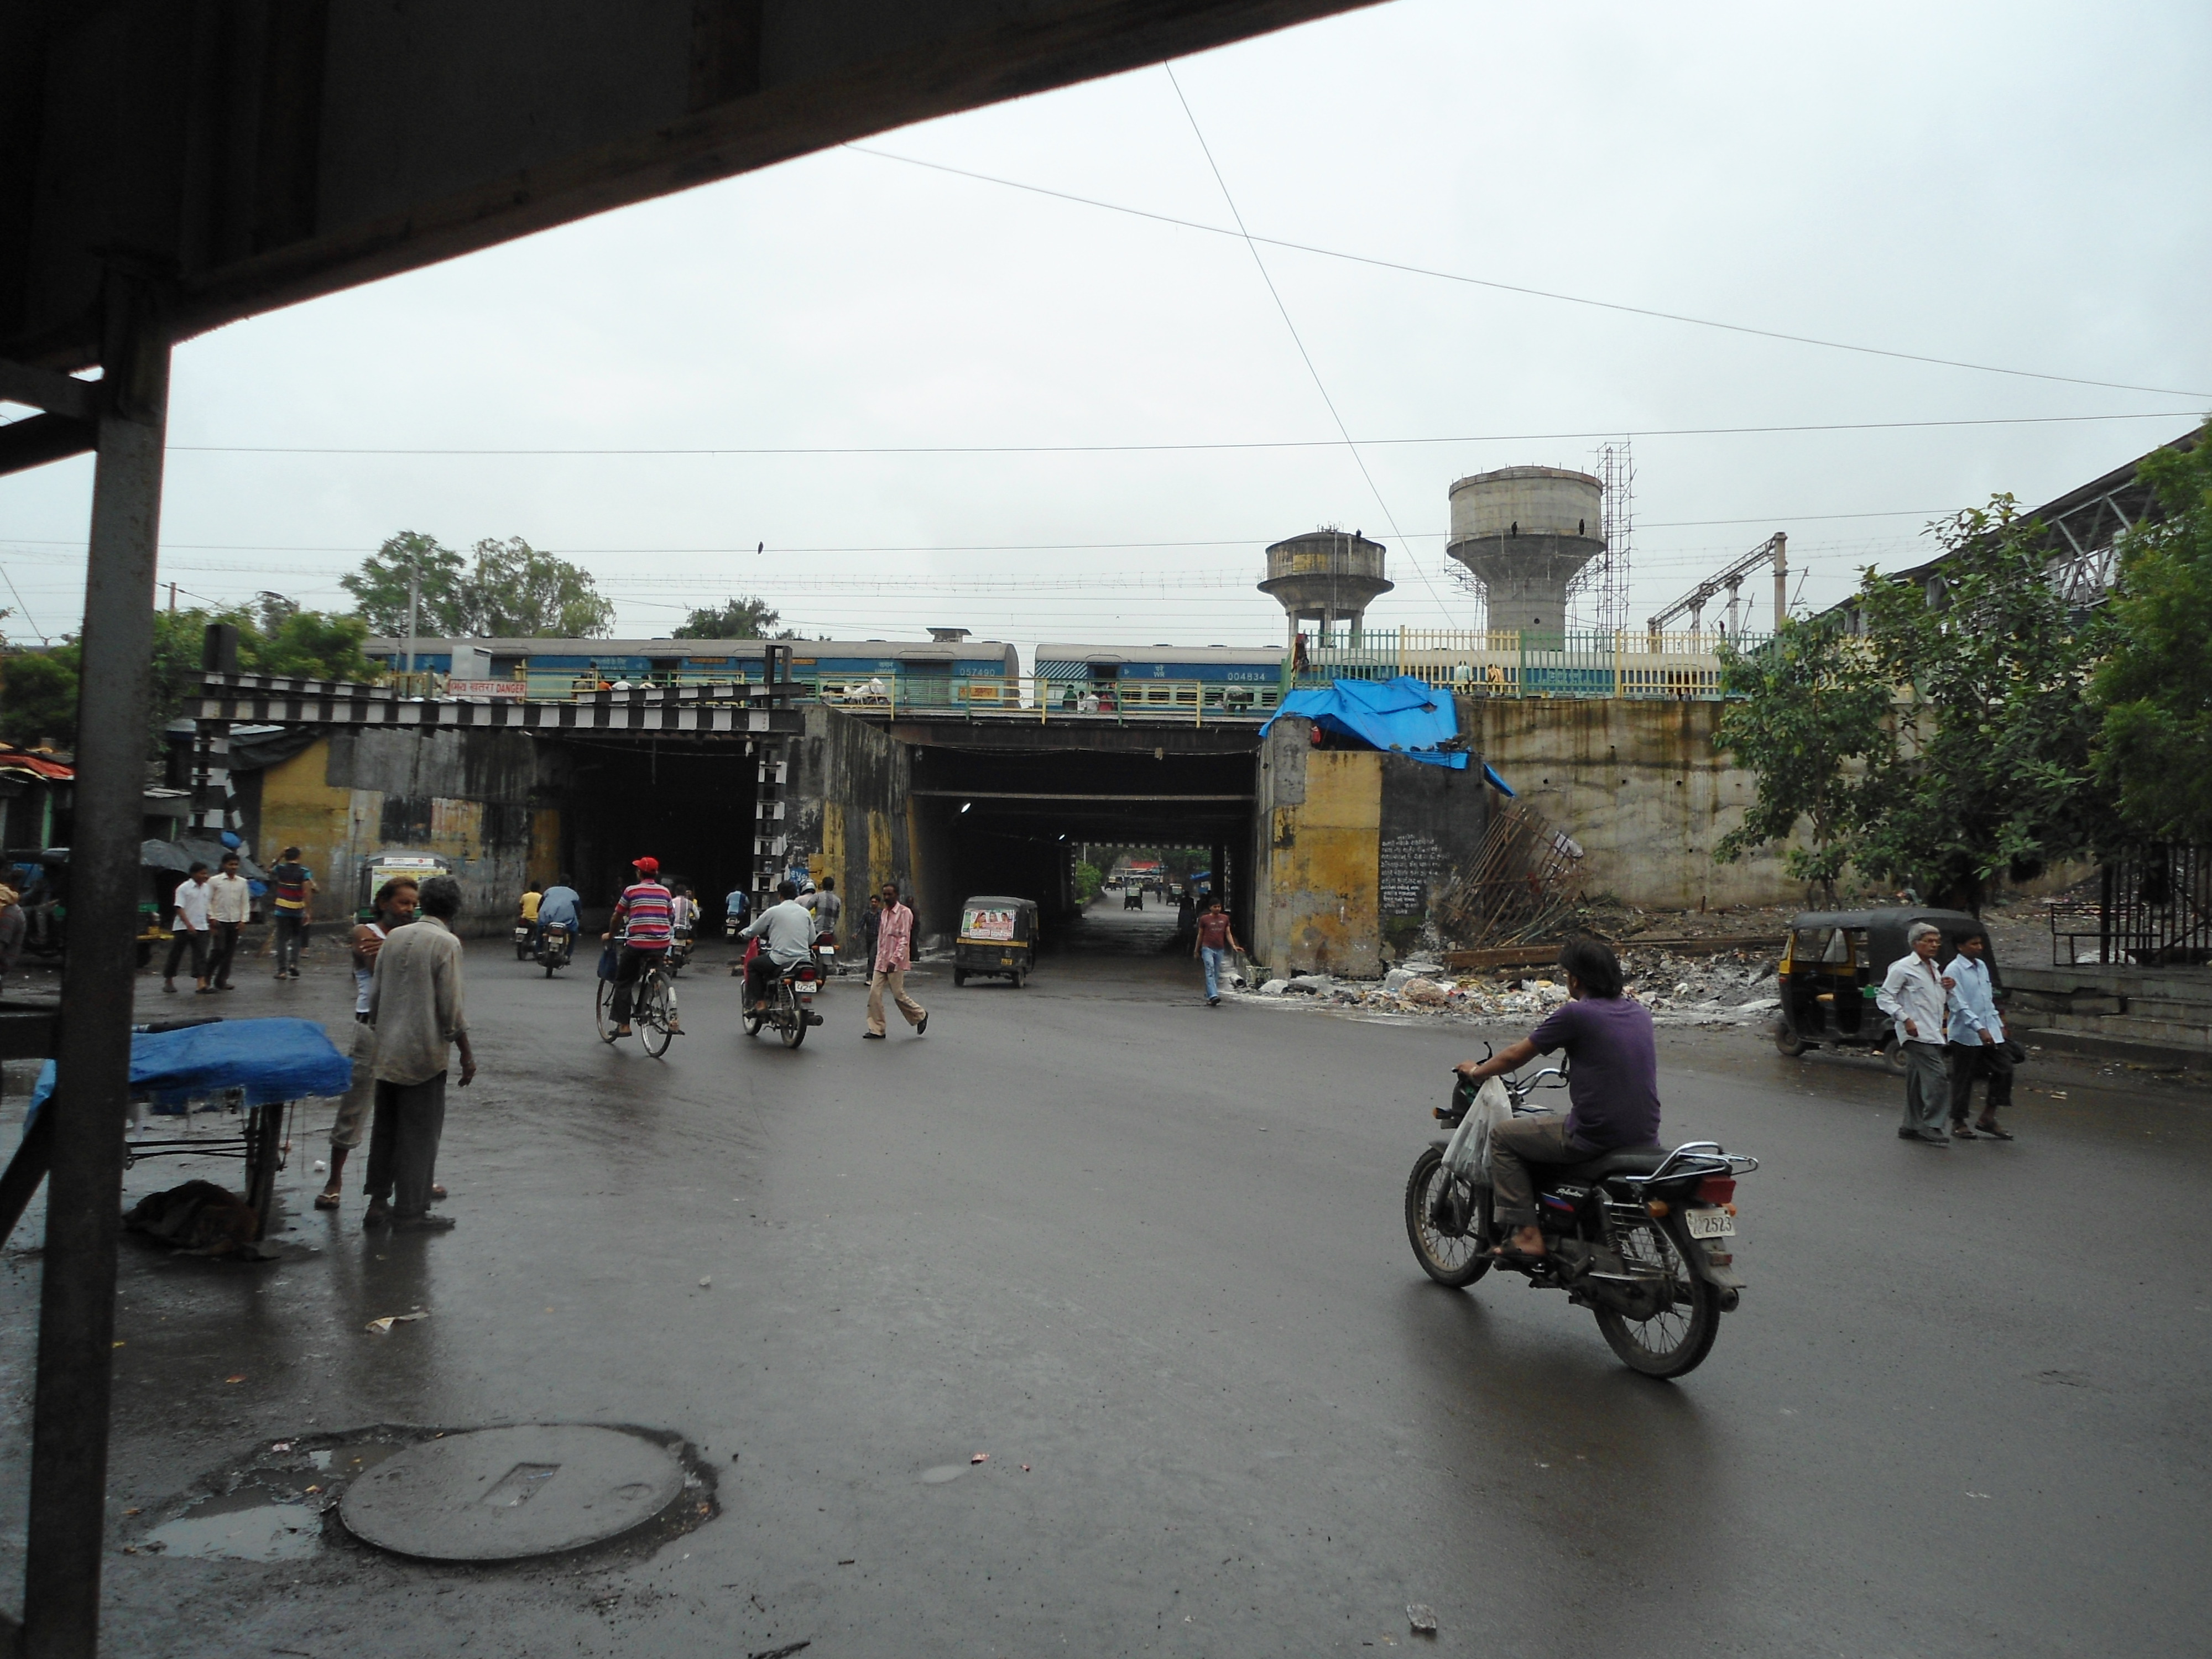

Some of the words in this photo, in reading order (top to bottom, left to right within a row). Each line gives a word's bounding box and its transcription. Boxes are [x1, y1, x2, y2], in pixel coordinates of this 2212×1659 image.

[959, 668, 995, 676] 057490
[1227, 672, 1265, 681] 004834
[470, 683, 494, 692] खतरा
[496, 684, 525, 693] DANGER
[1703, 1217, 1731, 1233] 2523
